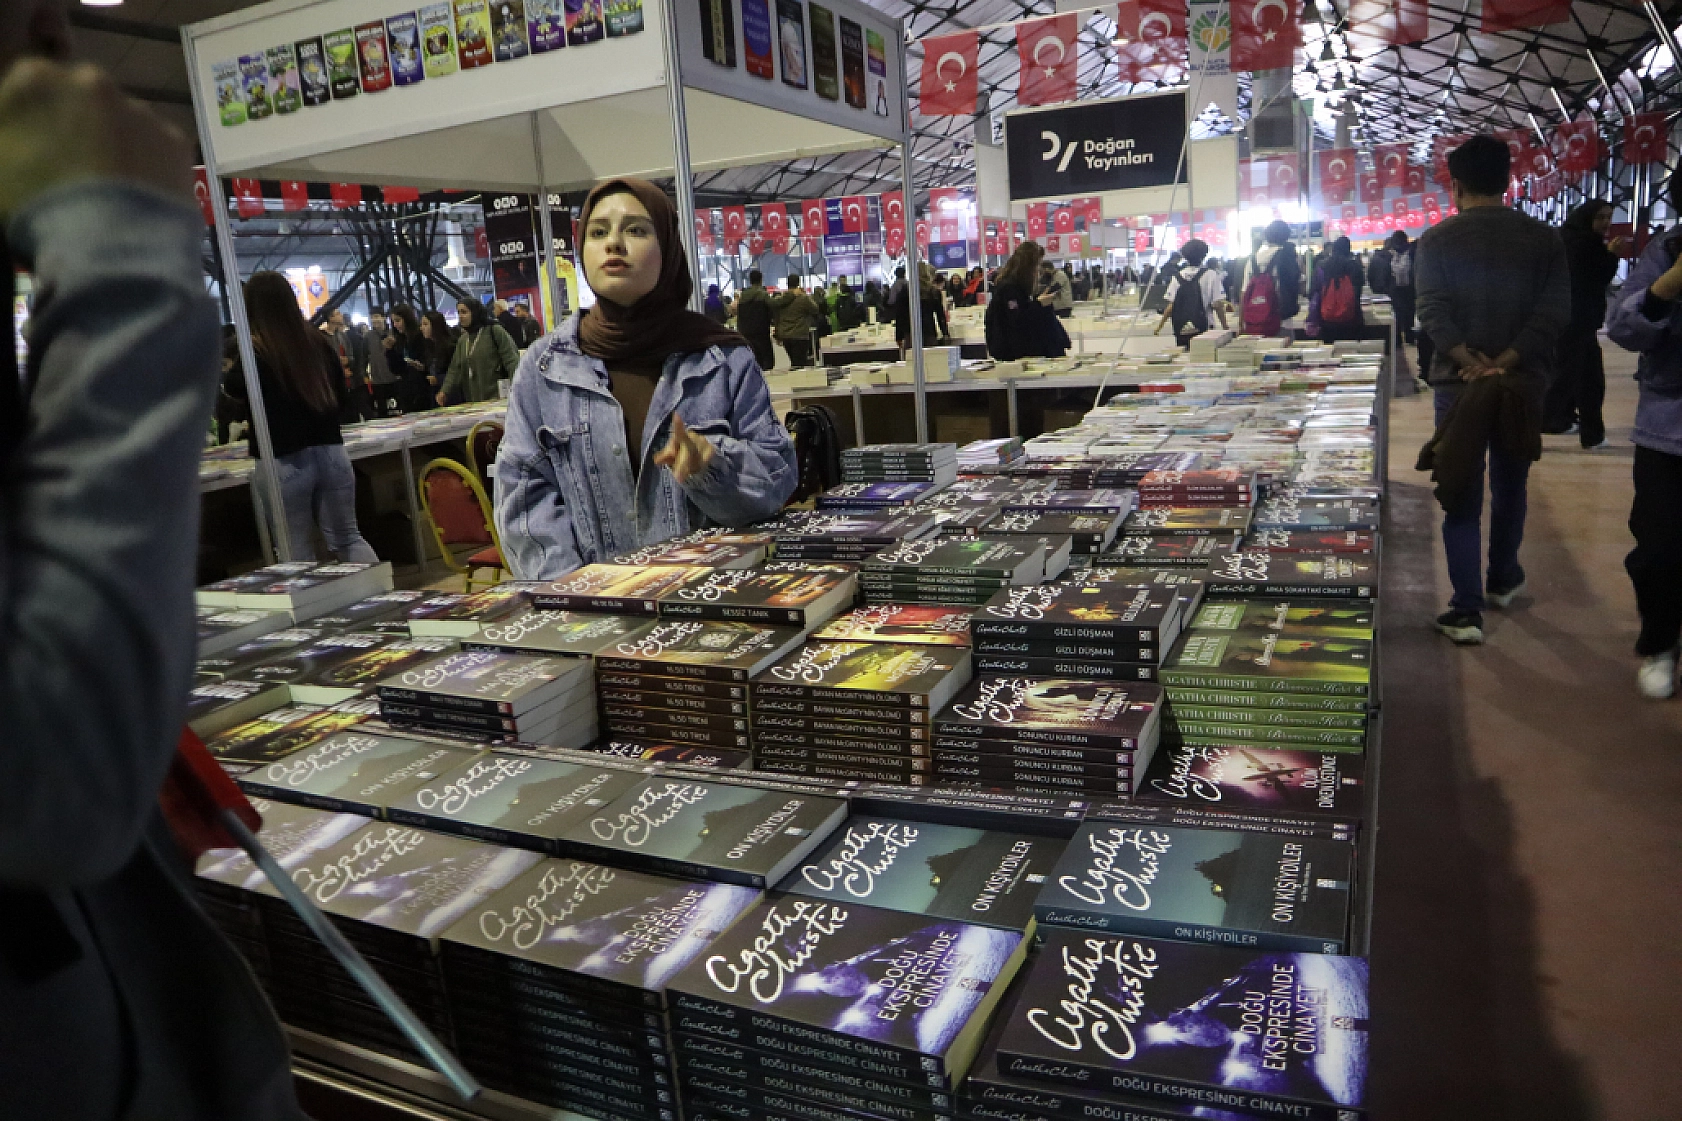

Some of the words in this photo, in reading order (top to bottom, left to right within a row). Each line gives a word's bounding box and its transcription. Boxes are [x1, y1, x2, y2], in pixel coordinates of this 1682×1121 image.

[1084, 137, 1135, 154] Doğan
[1084, 152, 1153, 171] Yayınları
[1054, 628, 1075, 637] GİZLİ
[1076, 628, 1114, 639] DÜŞMAN
[1055, 645, 1076, 654] GİZLİ
[1078, 646, 1114, 657] DÜŞMAN
[1054, 663, 1075, 673] GİZLİ
[1076, 664, 1114, 676] DÜŞMAN
[1166, 676, 1207, 687] AGATHA
[1209, 678, 1257, 689] CHRISTIE
[1167, 692, 1206, 703] AGATHA
[1208, 693, 1256, 705] CHRISTIE
[1013, 744, 1050, 756] SONUNCU
[1050, 748, 1083, 759] KURBAN
[1017, 731, 1054, 741] SONUNCU
[1055, 733, 1088, 743] KURBAN
[417, 757, 511, 810] Agatha
[443, 757, 532, 815] Christie
[589, 782, 681, 842] Agatha
[622, 783, 709, 847] Christie
[725, 844, 746, 860] ON
[743, 799, 805, 850] KİŞİYDİLER
[801, 822, 884, 892] Agatha
[843, 823, 920, 898] Christie
[971, 893, 990, 911] ON
[983, 840, 1033, 894] KİŞİYDİLER
[1058, 828, 1128, 905] Agatha
[1113, 829, 1173, 911] Christie
[1274, 842, 1304, 902] KİŞİYDİLER
[479, 862, 583, 942] Agatha
[512, 865, 616, 950] Christie
[1272, 903, 1293, 923] ON
[705, 901, 812, 993] Agatha
[750, 903, 849, 1004] Christie
[1174, 926, 1192, 938] ON
[1193, 929, 1258, 946] KİŞİYDİLER
[877, 930, 959, 1021] EKSPRESİNDE
[878, 948, 919, 989] DOĞU
[912, 947, 957, 1009] CİNAYET
[1027, 938, 1107, 1051] Agatha
[1091, 940, 1161, 1061] Christie
[1241, 991, 1267, 1036] DOĞU
[1262, 962, 1296, 1072] EKSPRESİNDE
[1292, 985, 1317, 1055] CİNAYET
[751, 1016, 781, 1033] DOĞU
[782, 1023, 853, 1051] EKSPRESİNDE
[853, 1041, 902, 1063] CİNAYET
[756, 1035, 786, 1052] DOĞU
[787, 1041, 859, 1069] EKSPRESİNDE
[860, 1058, 908, 1079] CİNAYET
[759, 1056, 789, 1072] DOĞU
[791, 1063, 862, 1090] EKSPRESİNDE
[862, 1077, 912, 1099] CİNAYET
[764, 1075, 794, 1091] DOĞU
[795, 1083, 865, 1109] EKSPRESİNDE
[866, 1098, 916, 1120] CİNAYET
[1112, 1075, 1150, 1092] DOĞU
[1153, 1083, 1247, 1108] EKSPRESİNDE
[1250, 1098, 1312, 1118] CİNAYET
[1083, 1104, 1120, 1121] DOĞU
